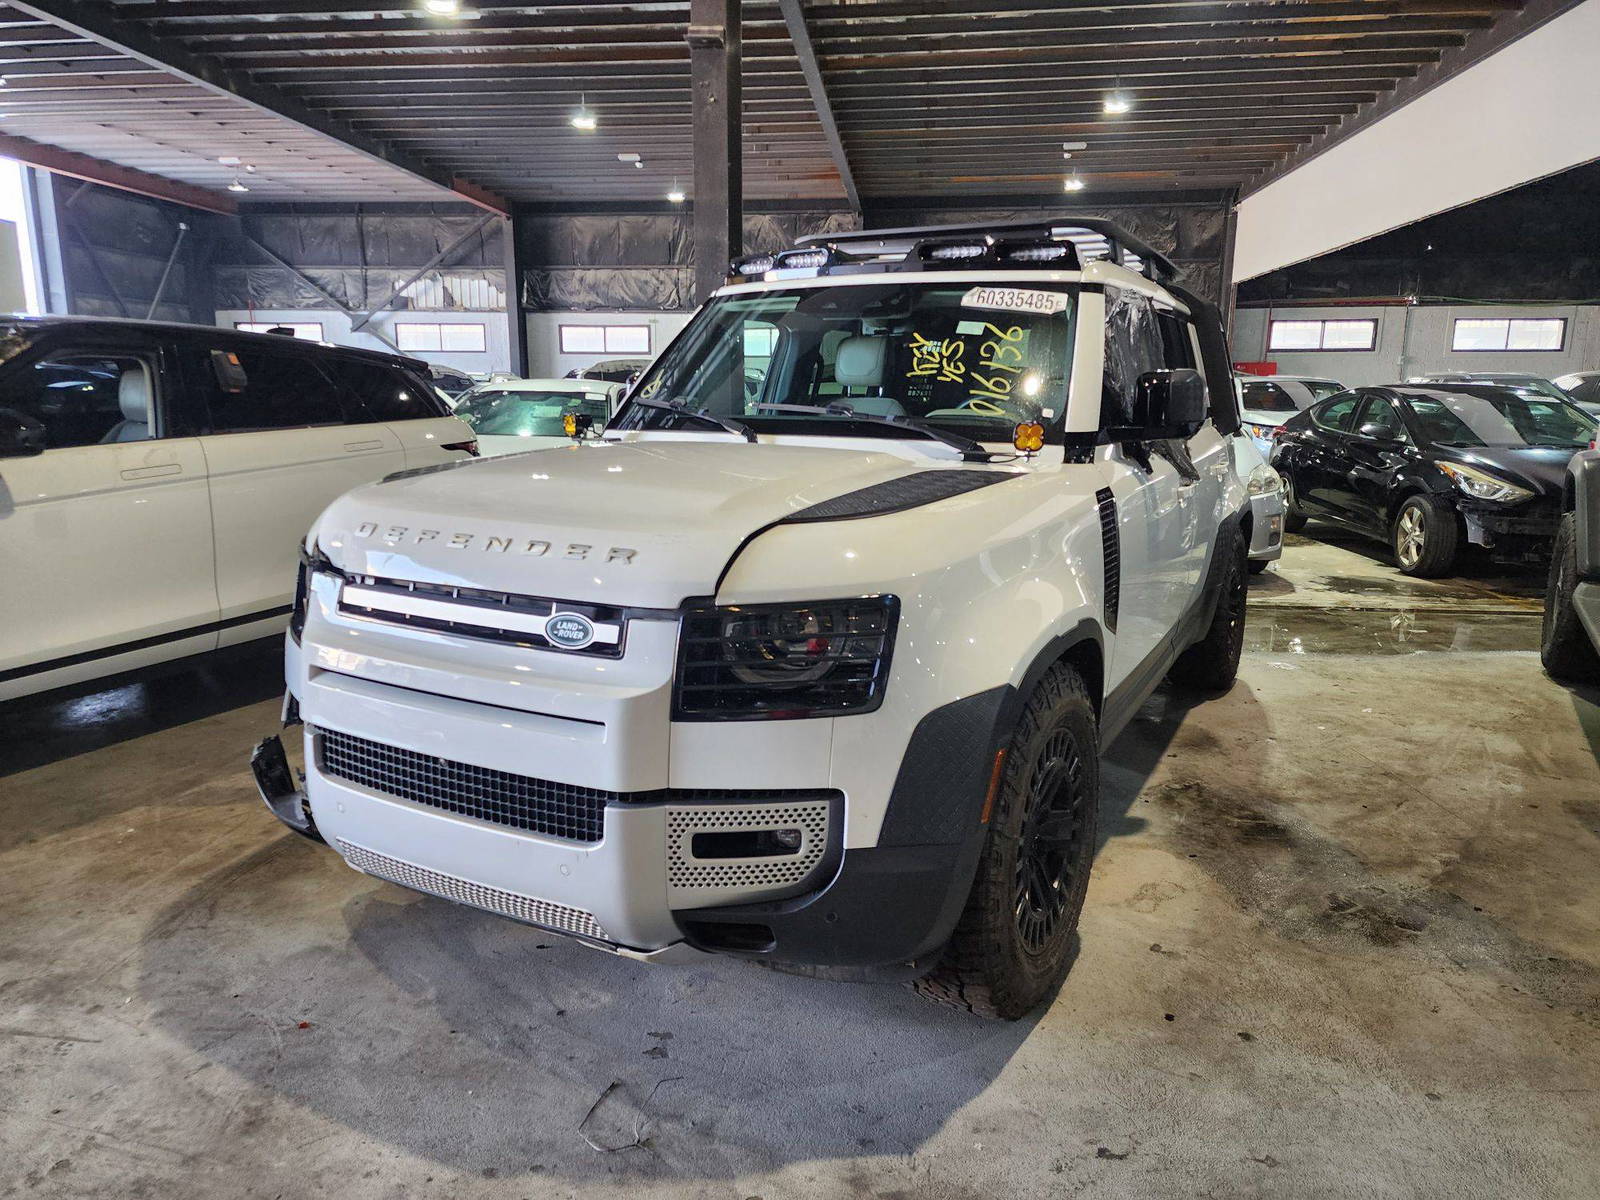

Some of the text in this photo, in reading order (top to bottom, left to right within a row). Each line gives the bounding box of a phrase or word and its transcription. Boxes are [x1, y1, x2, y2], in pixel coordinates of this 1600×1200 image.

[976, 289, 1055, 310] 60335485
[936, 338, 965, 383] YES
[355, 522, 640, 565] DEFENDER
